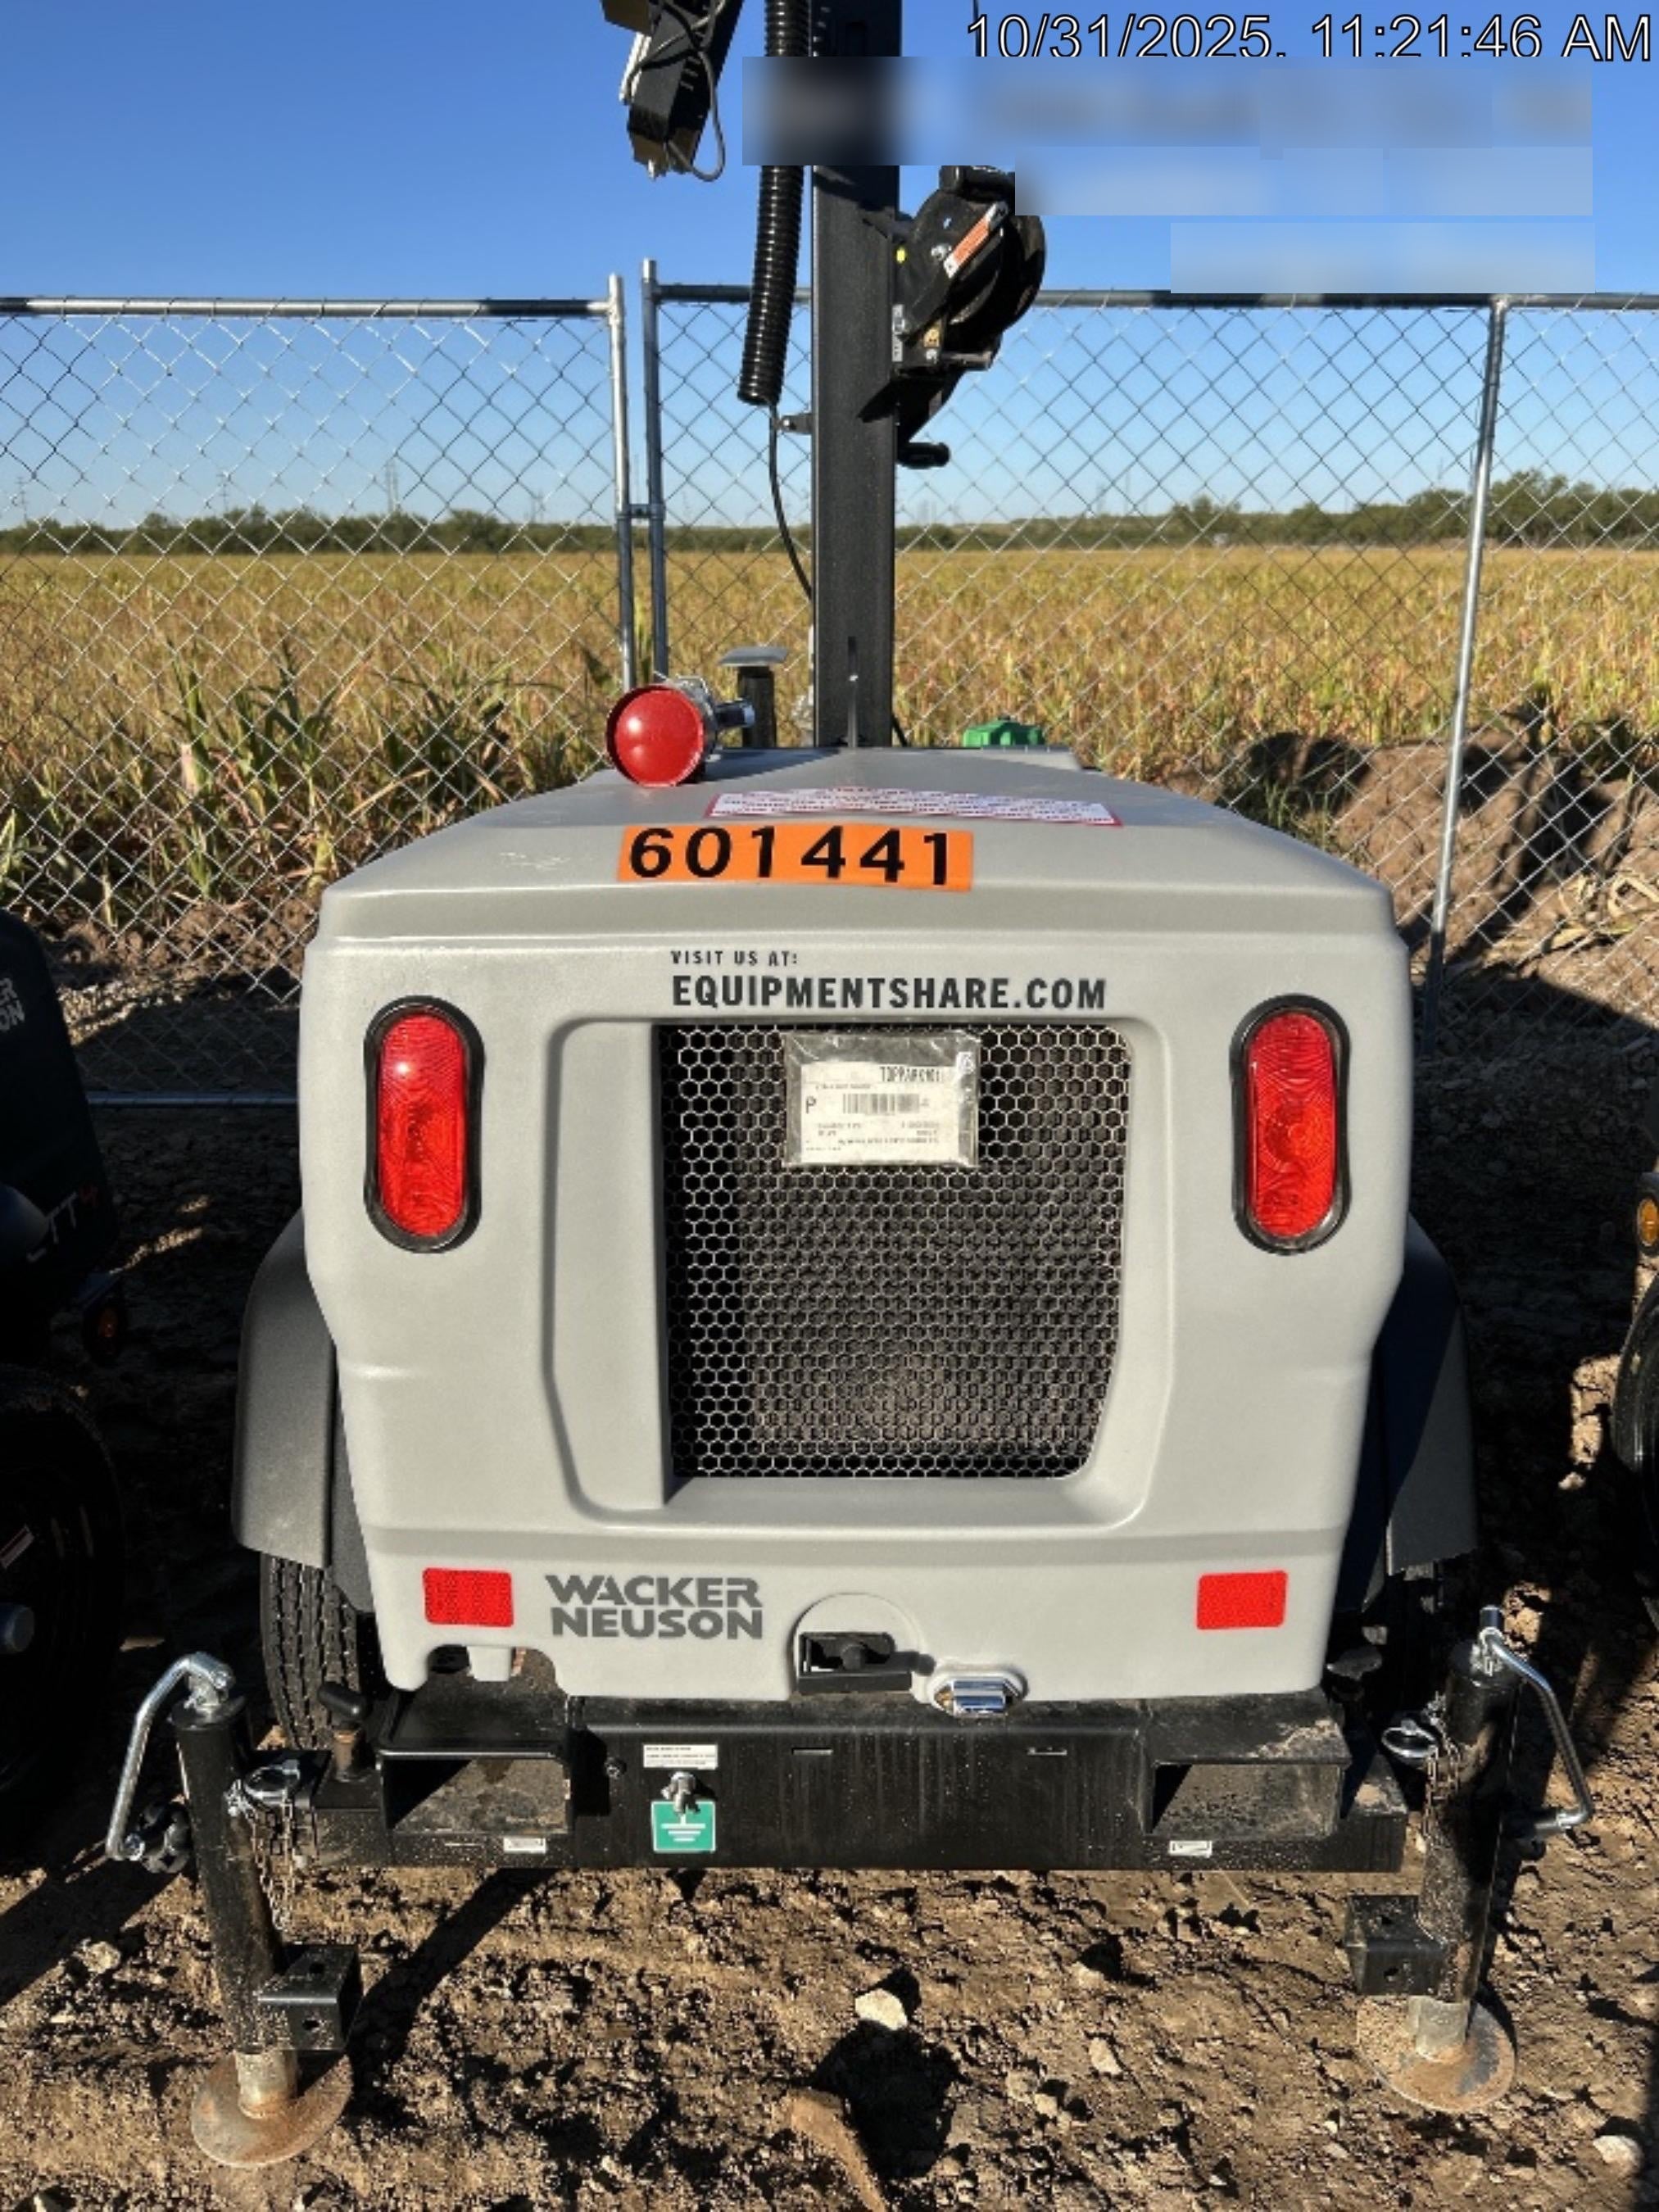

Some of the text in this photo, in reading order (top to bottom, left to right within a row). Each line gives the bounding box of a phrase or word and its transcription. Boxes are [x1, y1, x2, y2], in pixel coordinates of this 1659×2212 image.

[629, 826, 949, 886] 601441
[671, 950, 799, 966] VISIT US AT:
[672, 975, 1107, 1010] EQUIPMENTSHARE.COM
[545, 1574, 763, 1607] WACKER
[551, 1607, 763, 1640] NEUSON
